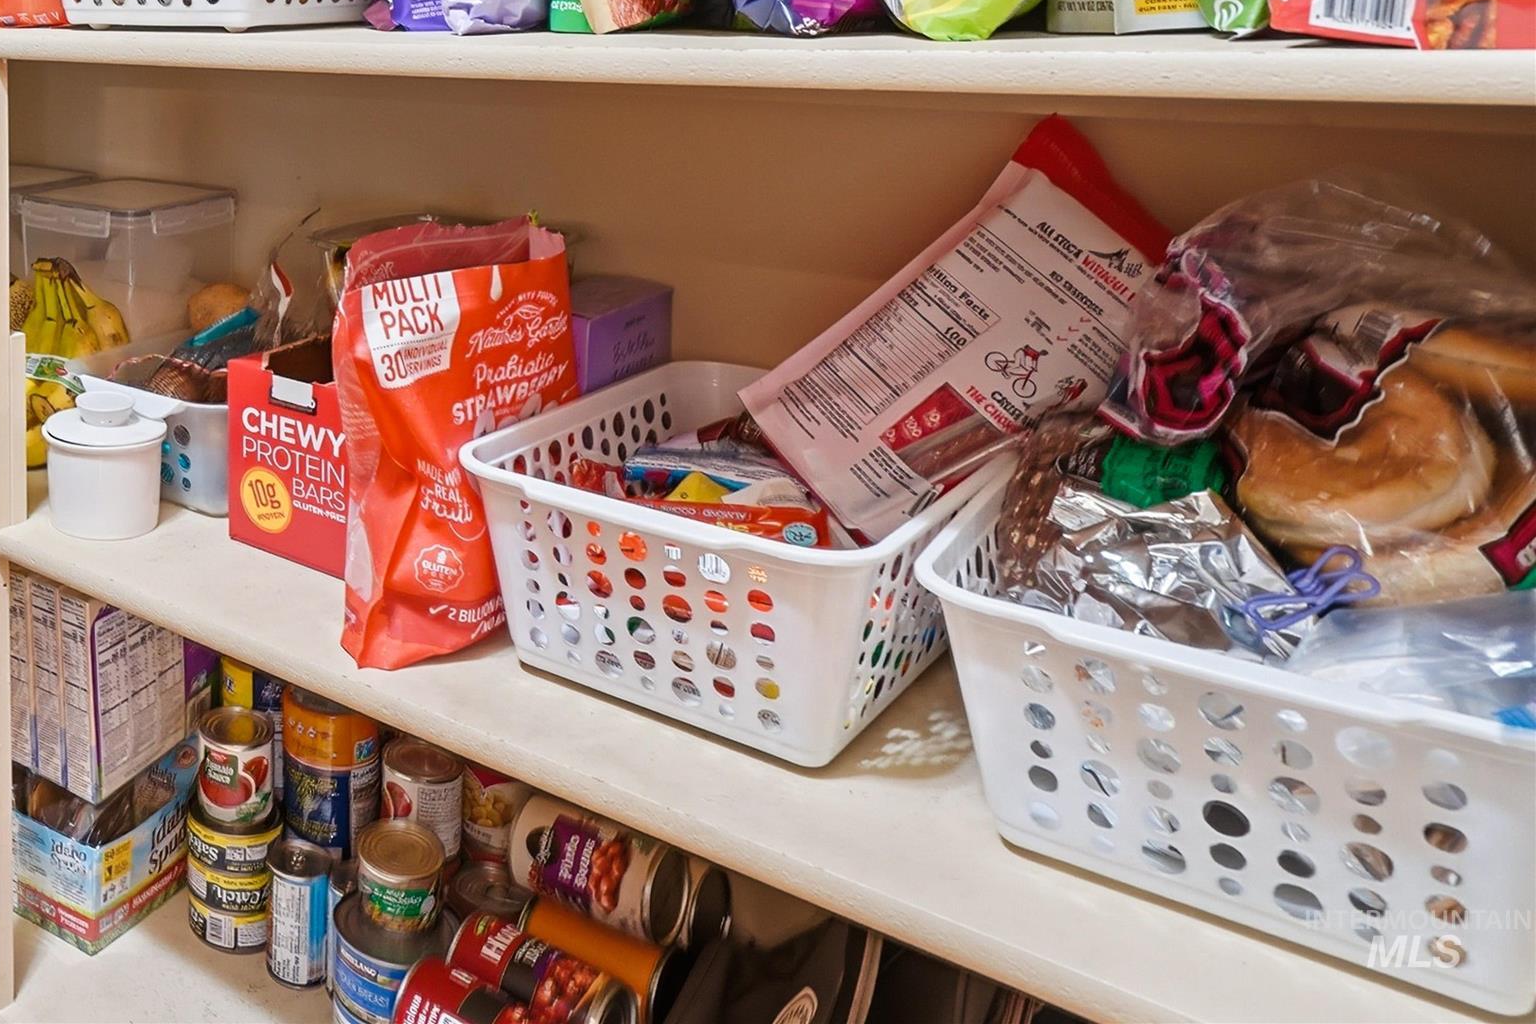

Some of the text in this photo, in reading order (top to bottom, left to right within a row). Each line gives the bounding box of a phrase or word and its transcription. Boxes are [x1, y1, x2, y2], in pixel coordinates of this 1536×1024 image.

[372, 273, 443, 309] MULTI
[959, 284, 991, 321] Facts
[379, 302, 445, 340] PACK
[380, 349, 408, 382] 30
[472, 351, 556, 390] Probiotic
[451, 360, 570, 425] STRAWBERRY
[242, 406, 346, 458] CHEWY
[242, 435, 345, 489] PROTEIN
[416, 458, 444, 483] MADE
[248, 479, 281, 510] 10g
[292, 477, 345, 512] BARS
[420, 486, 474, 525] Fruit
[433, 483, 462, 503] REAL
[292, 499, 347, 523] GLUTEN-FREE
[421, 558, 458, 576] GLUTEN
[448, 597, 495, 623] 2 BILLION
